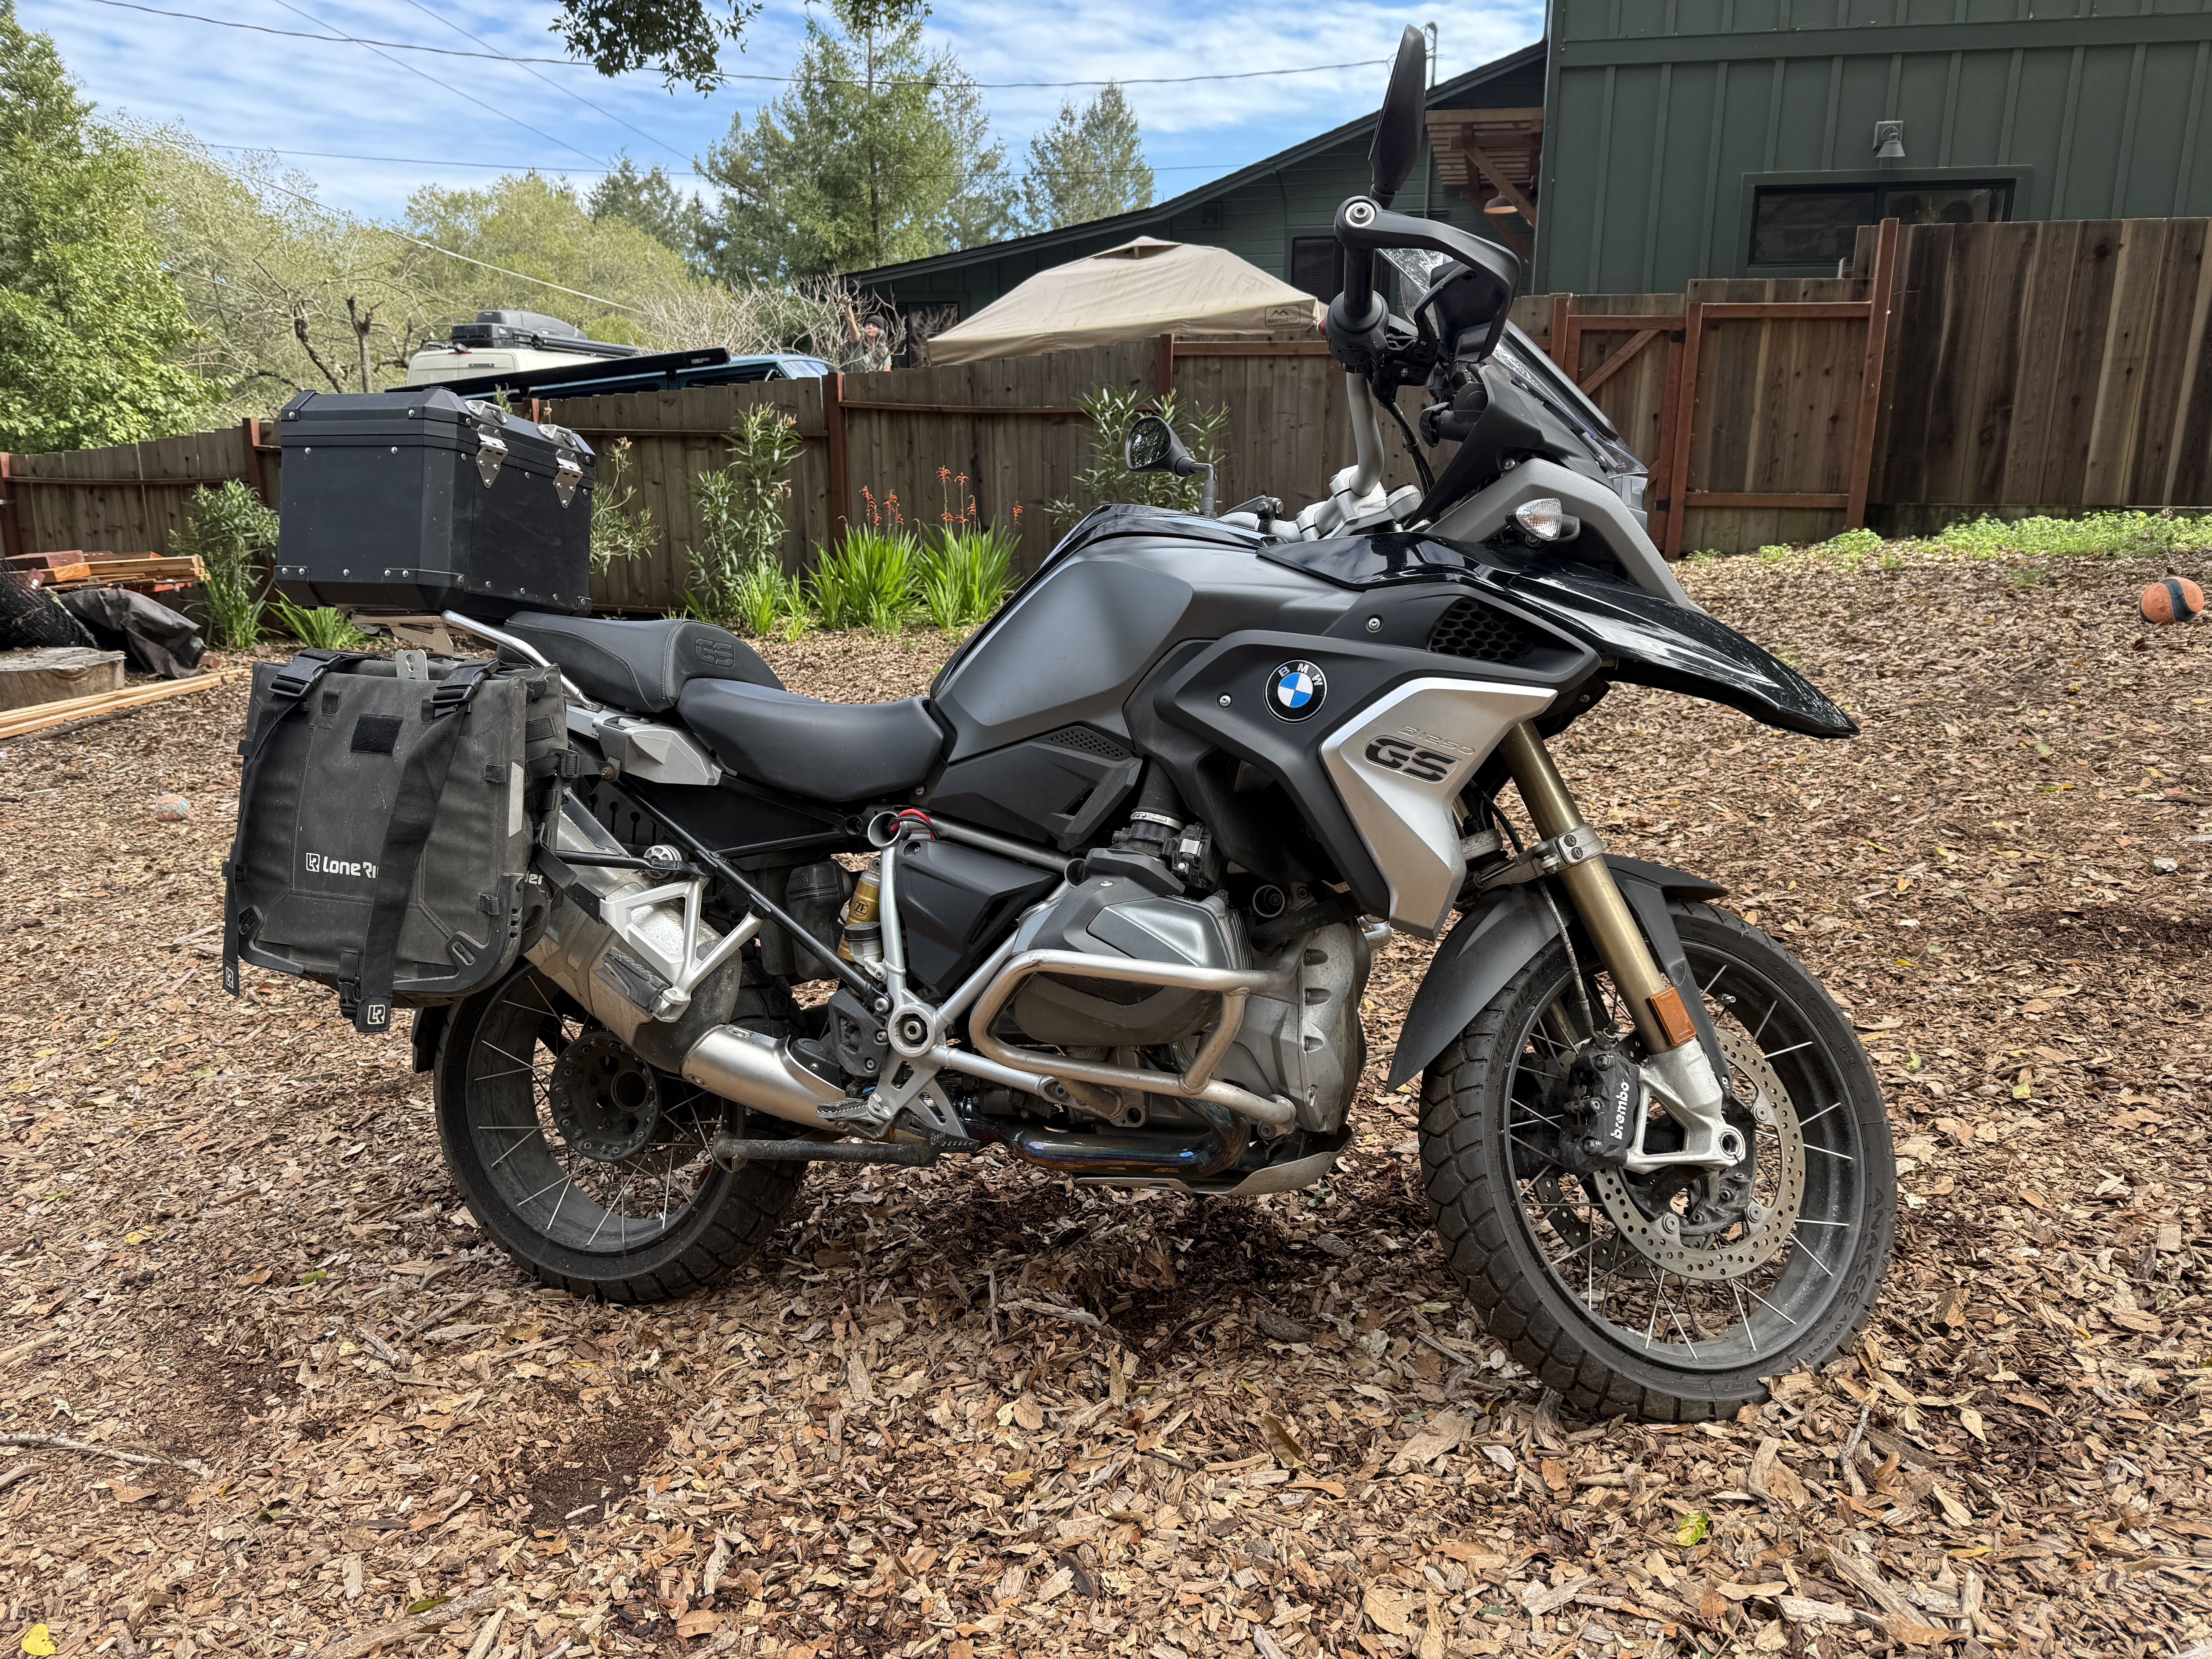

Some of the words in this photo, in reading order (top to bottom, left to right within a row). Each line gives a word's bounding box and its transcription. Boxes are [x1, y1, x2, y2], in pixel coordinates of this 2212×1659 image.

[695, 639, 735, 668] GS
[1278, 663, 1323, 686] BMW
[1398, 725, 1475, 754] R1250
[1365, 737, 1457, 781] GS
[855, 900, 869, 915] ZF
[1492, 985, 1532, 1068] MICHELIN
[1611, 1081, 1629, 1140] brembo
[1844, 1187, 1884, 1310] ANAKEE
